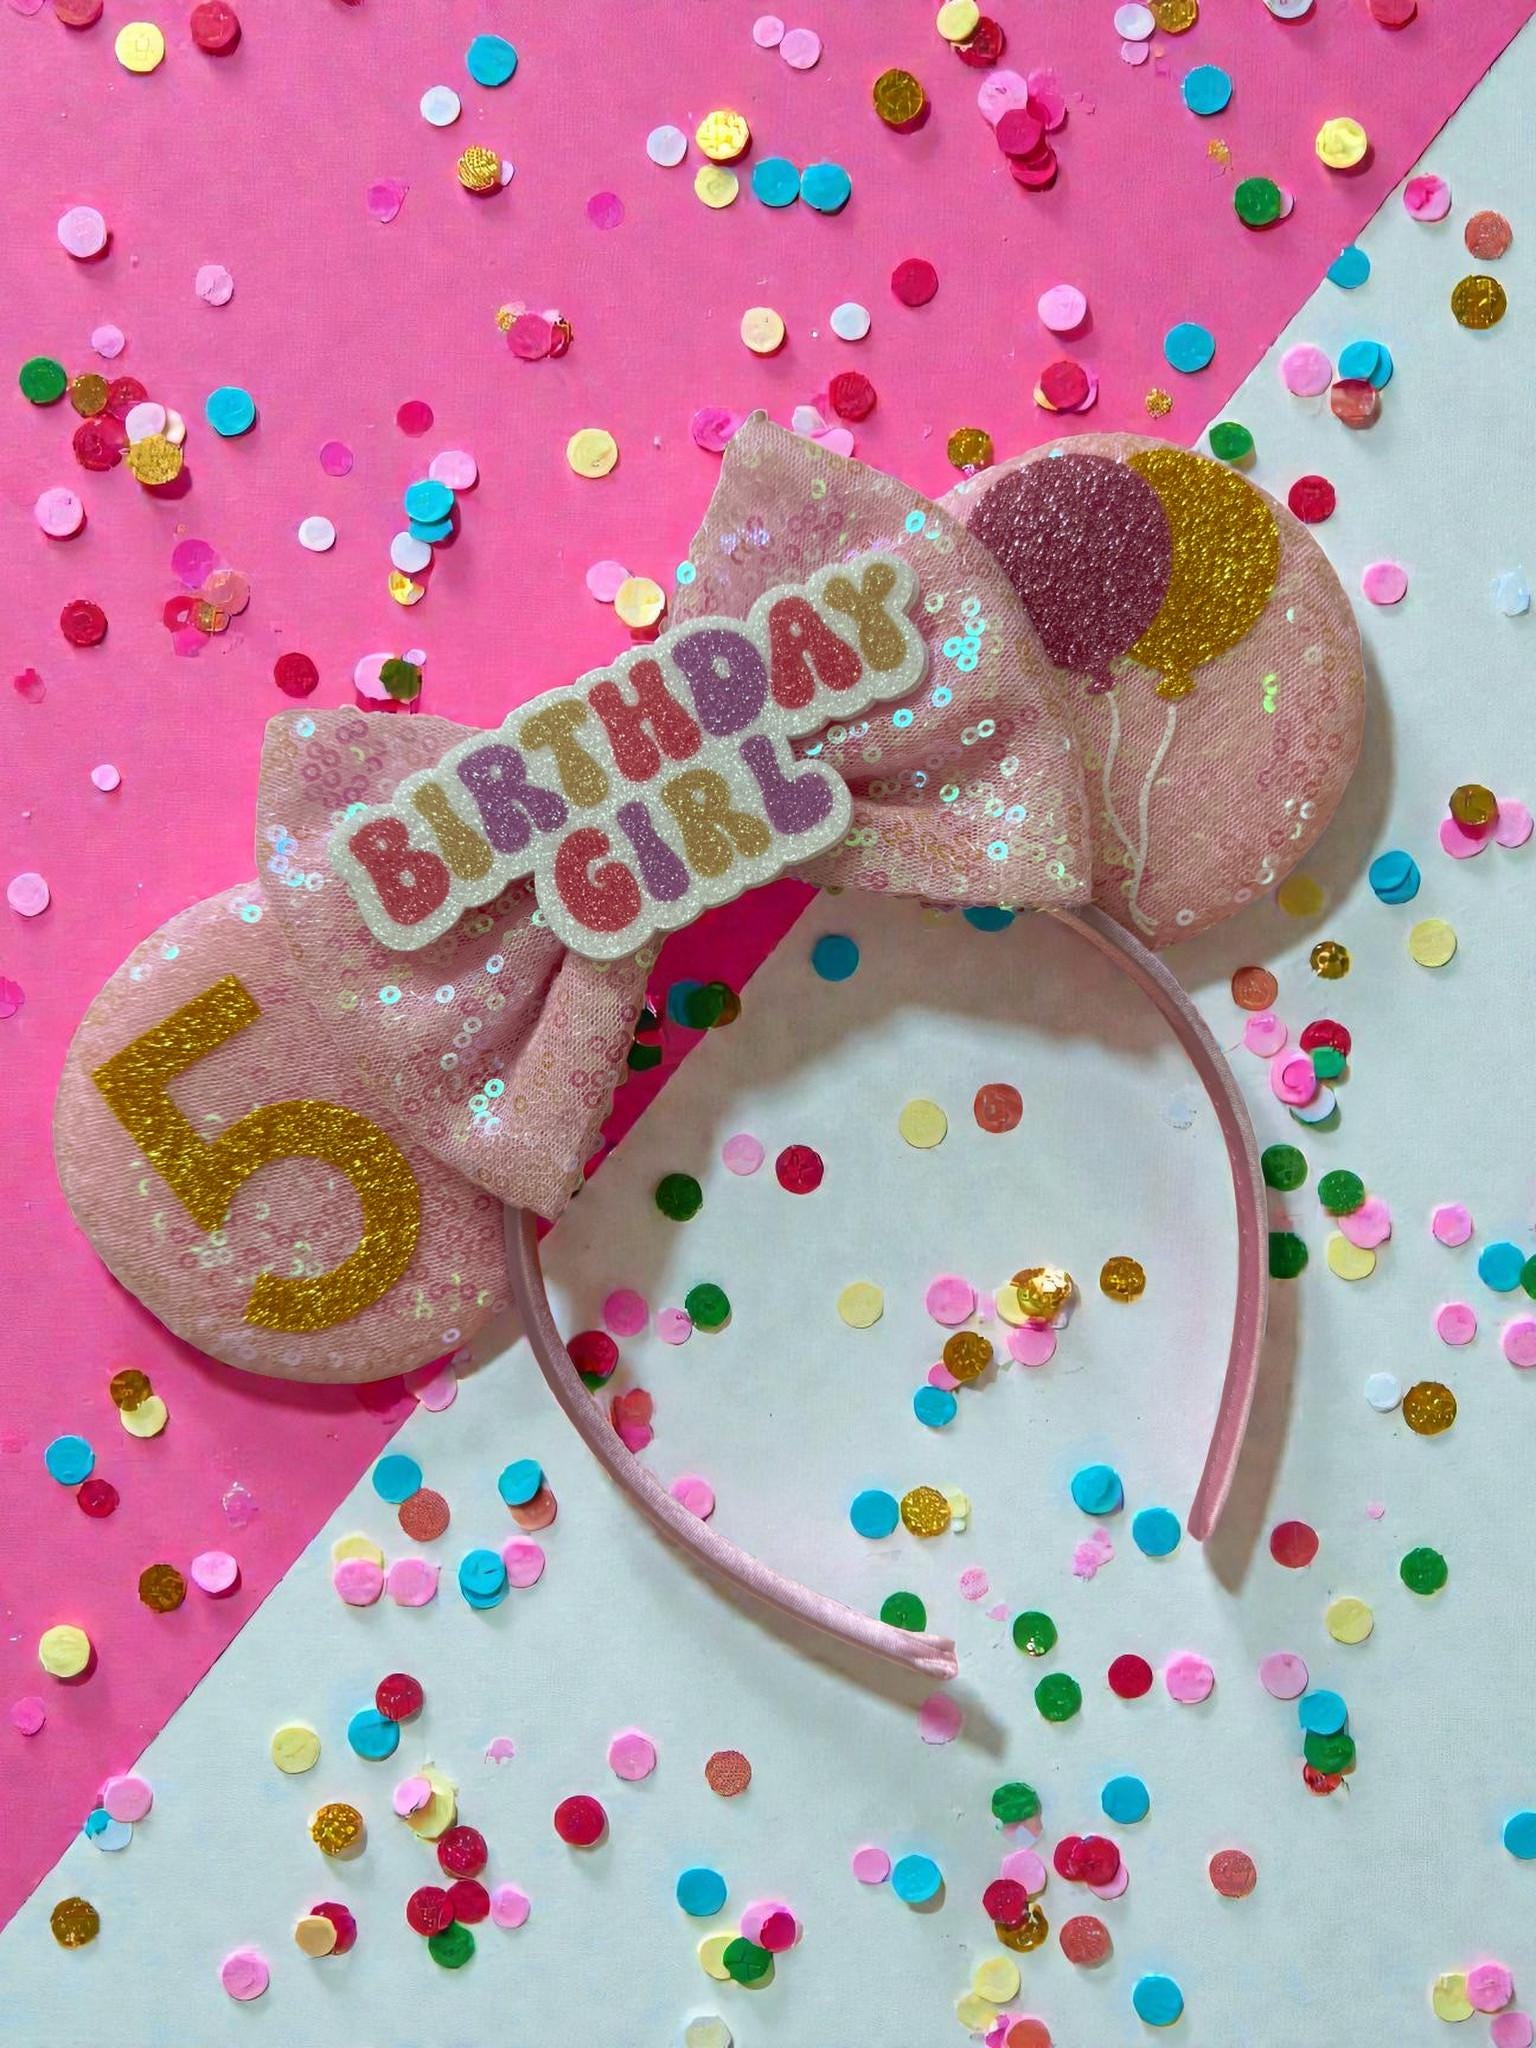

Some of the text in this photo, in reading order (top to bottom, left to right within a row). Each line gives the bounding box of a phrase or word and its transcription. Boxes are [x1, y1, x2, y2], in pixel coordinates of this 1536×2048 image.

[349, 563, 908, 925] BIRTHDAY
[554, 735, 833, 933] GIRL
[91, 974, 421, 1332] 5
